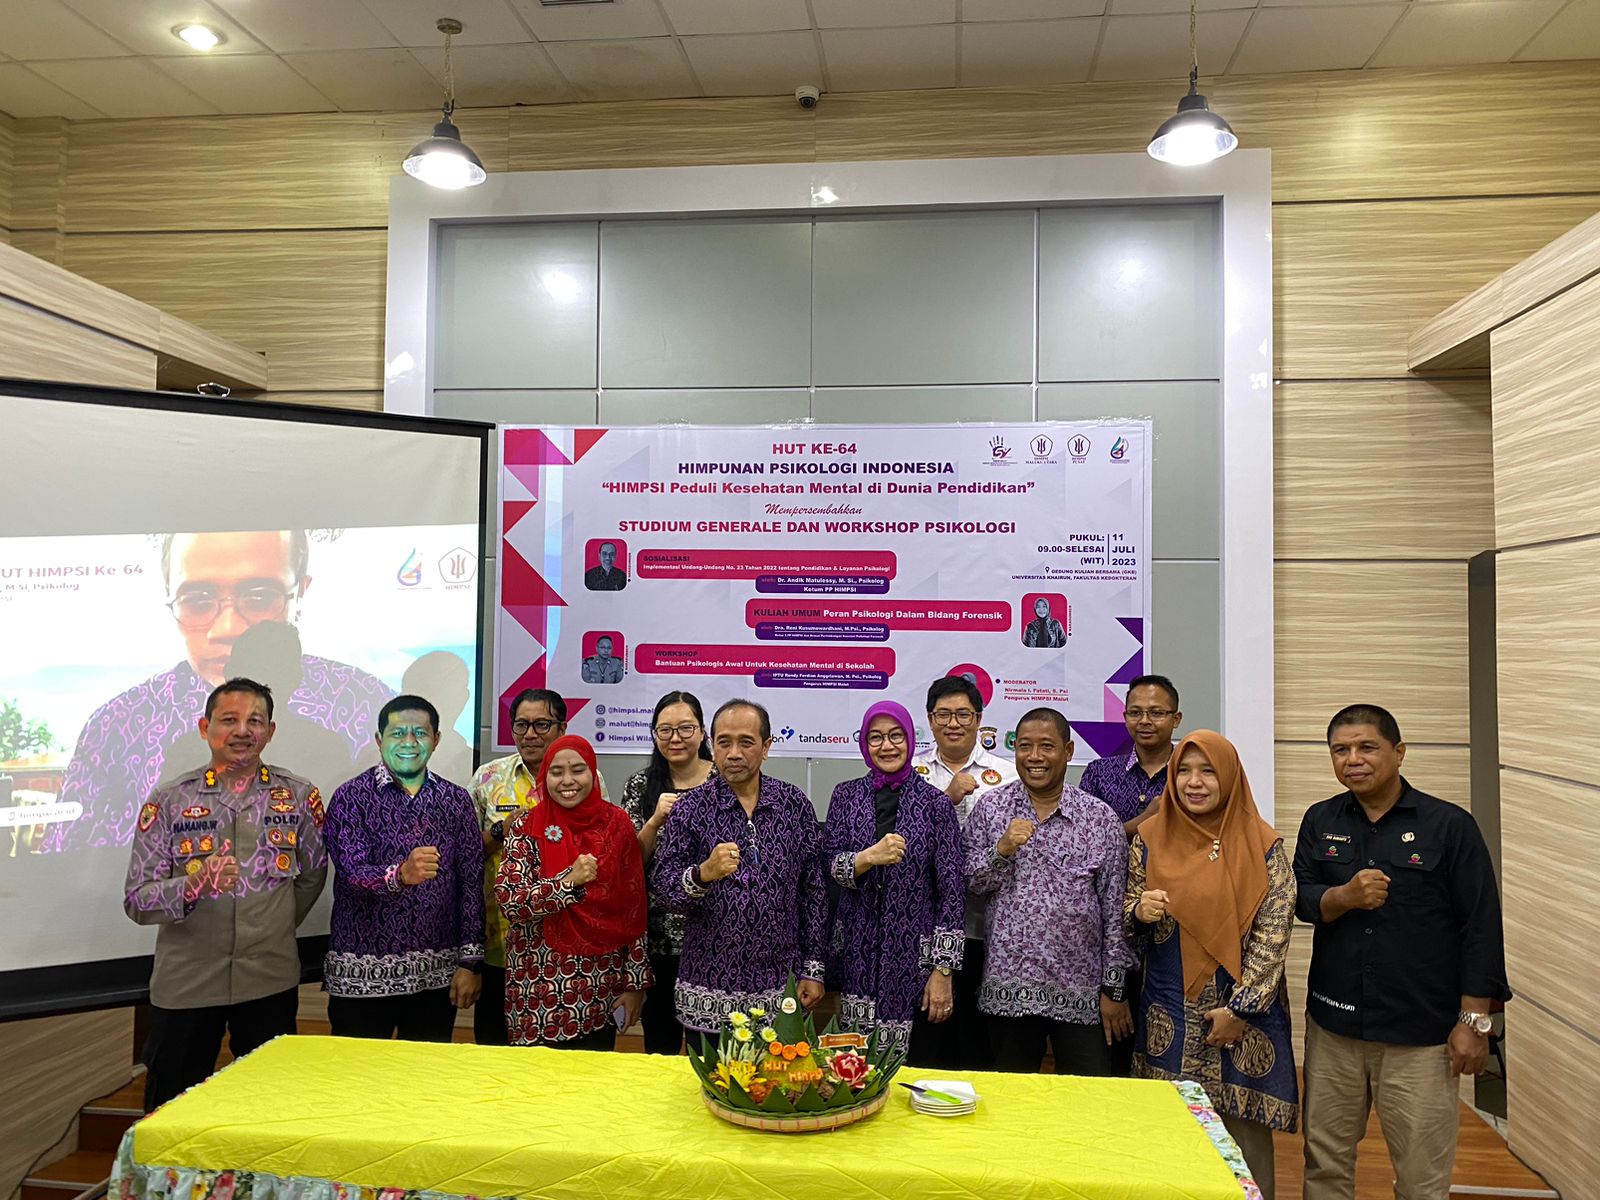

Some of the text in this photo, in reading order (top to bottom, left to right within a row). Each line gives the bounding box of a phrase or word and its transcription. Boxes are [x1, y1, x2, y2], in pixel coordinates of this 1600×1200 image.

[773, 443, 856, 454] HUT KE-64
[679, 463, 954, 474] HIMPUNAN PSIKOLOGI INDONESIA
[602, 482, 1034, 493] “HIMPSI Peduli Kesehatan Mental di Dunia Pendidikan”
[765, 504, 862, 517] Mempersembahkan
[619, 521, 1015, 533] STUDIUM GENERALE DAN WORKSHOP PSIKOLOGI
[29, 566, 89, 577] HIMPSI
[95, 565, 116, 575] Ke
[123, 564, 143, 575] 64
[754, 609, 788, 618] KULIAH
[792, 610, 820, 618] UMUM
[852, 610, 893, 618] Psikologi
[928, 610, 960, 619] Bidang
[799, 733, 849, 743] tandaseru
[264, 815, 299, 825] POLRI
[764, 1061, 790, 1071] HUT
